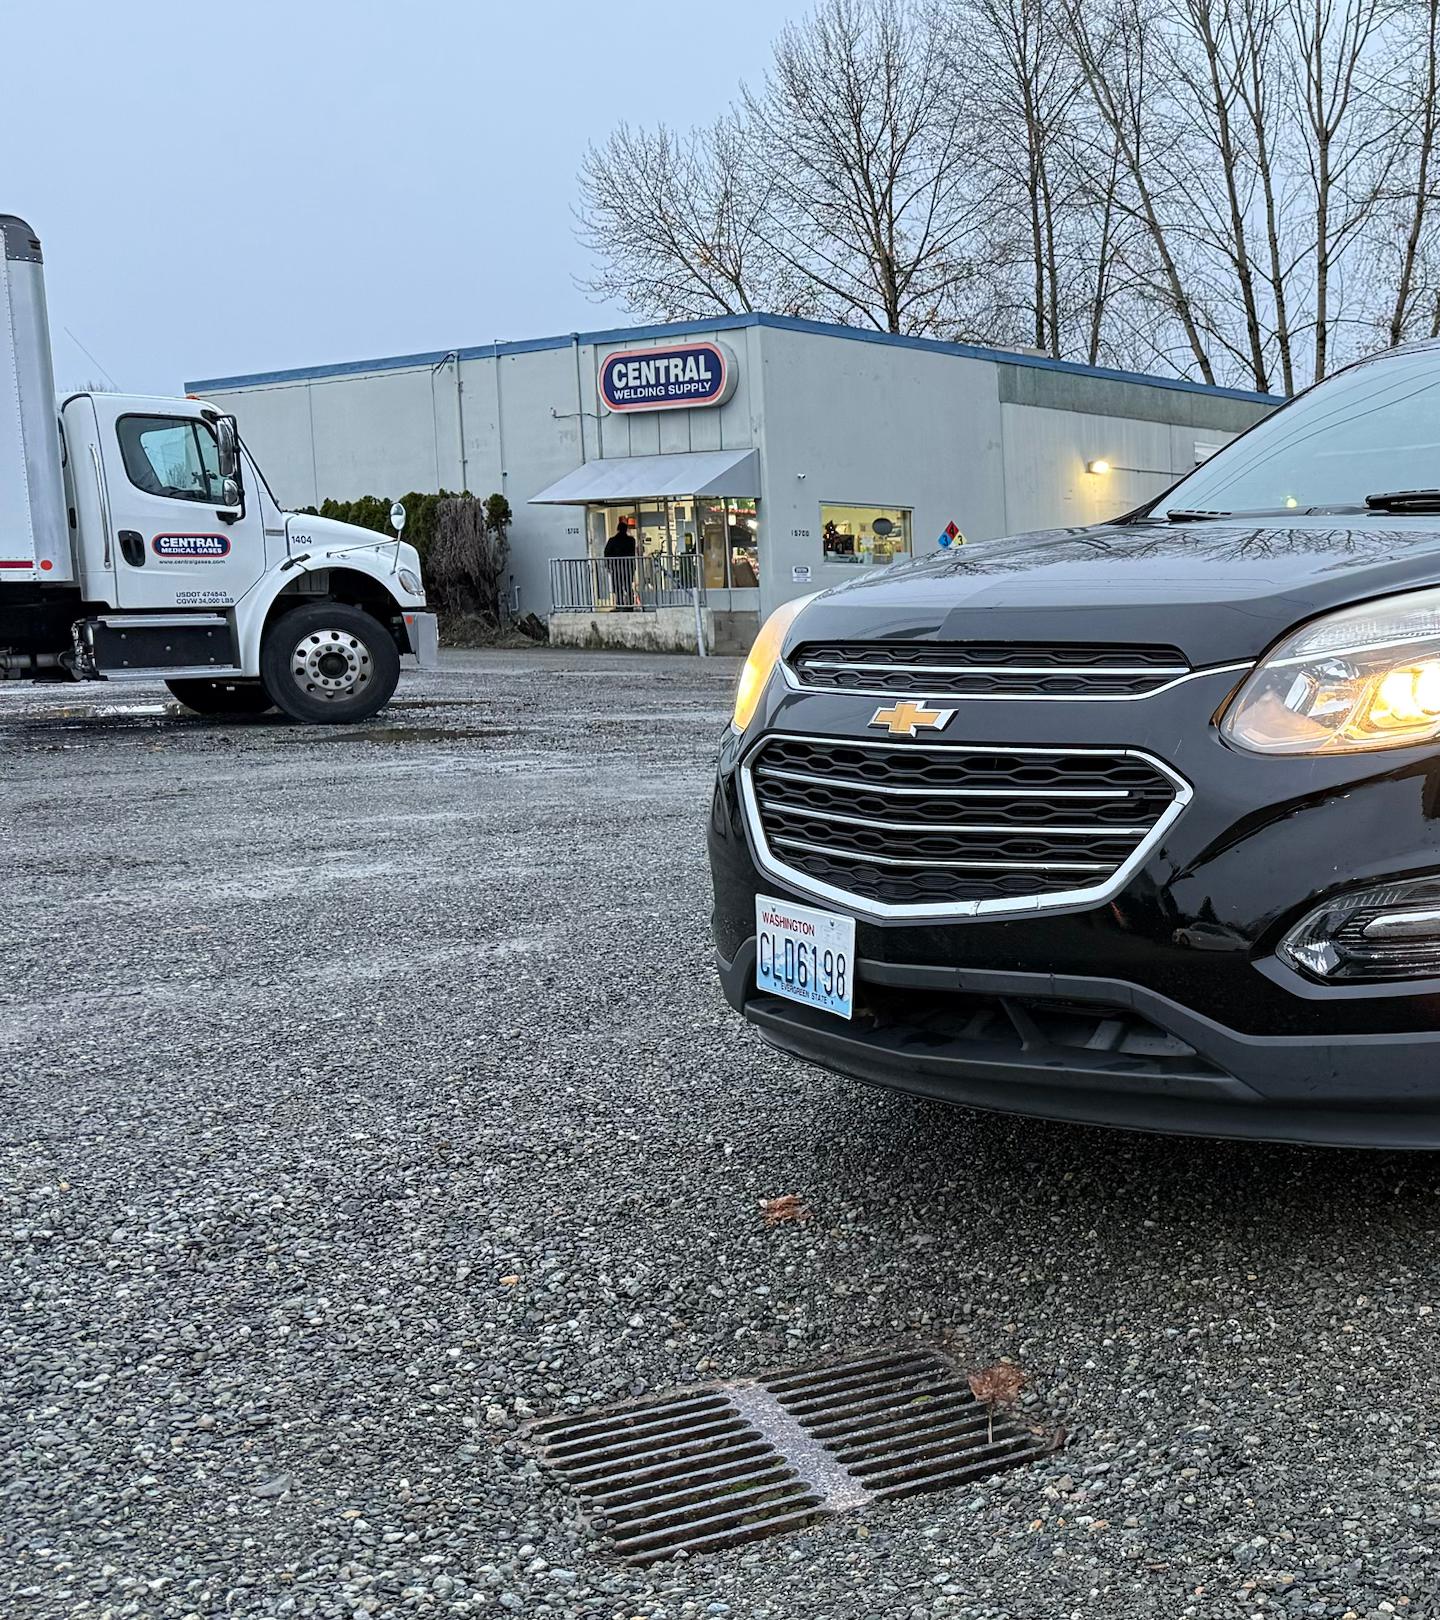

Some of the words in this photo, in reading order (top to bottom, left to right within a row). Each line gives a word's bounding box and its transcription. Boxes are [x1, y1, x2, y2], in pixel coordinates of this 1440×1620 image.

[612, 355, 712, 389] CENTRAL
[613, 385, 665, 400] WELDING
[668, 381, 712, 395] SUPPLY
[160, 537, 222, 548] CENTRAL
[291, 535, 312, 544] 1404
[762, 911, 815, 937] WASHINGTON
[760, 931, 846, 1000] CLD6198
[781, 982, 810, 999] EVERGREEN
[811, 992, 828, 1005] STATE
